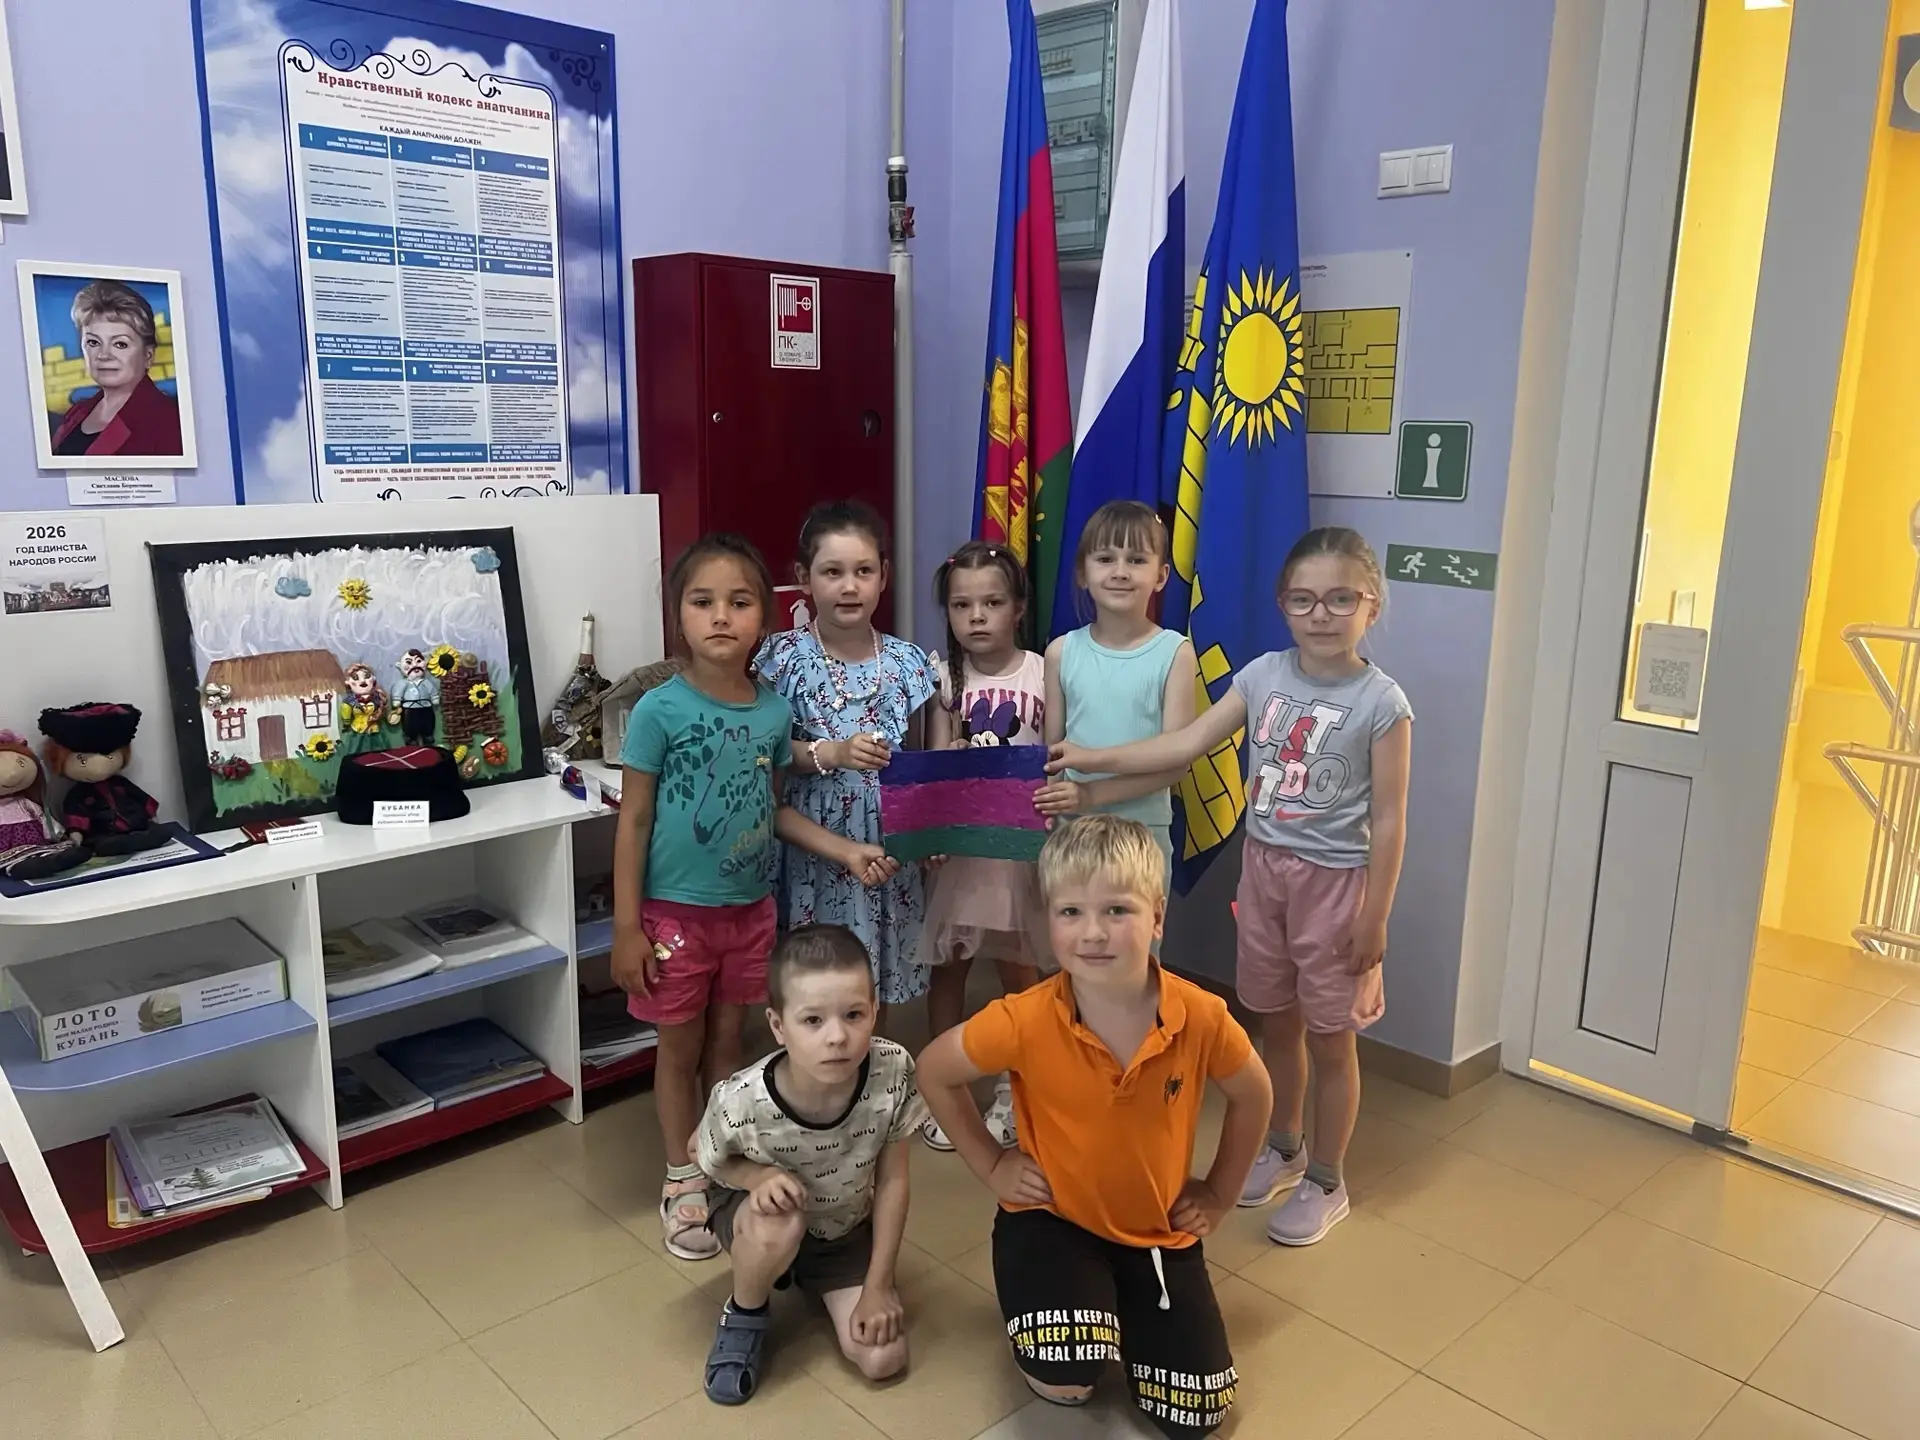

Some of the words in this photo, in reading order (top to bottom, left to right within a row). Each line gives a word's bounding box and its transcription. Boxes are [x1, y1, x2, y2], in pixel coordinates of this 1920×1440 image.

[318, 72, 423, 100] Нравственный
[427, 91, 473, 107] кодекс
[477, 100, 551, 121] анапчанина
[308, 132, 313, 142] 1
[379, 125, 411, 135] КАЖДЫЙ
[411, 130, 452, 141] АНАПЧАНИН
[397, 144, 403, 154] 2
[26, 525, 67, 540] 2026
[15, 546, 36, 555] ГОД
[37, 543, 88, 554] ЕДИНСТВА
[9, 557, 56, 567] НАРОДОВ
[58, 555, 97, 565] РОССИИ
[54, 1006, 116, 1031] ЛОТО
[56, 1030, 119, 1051] КУБАНЬ
[1022, 1312, 1033, 1328] IT
[1036, 1309, 1070, 1325] REAL
[1073, 1309, 1102, 1323] KEEP
[1104, 1312, 1112, 1326] IT
[1037, 1326, 1070, 1343] KEEP
[1074, 1326, 1088, 1340] IT
[1092, 1326, 1113, 1342] REAL
[1039, 1345, 1071, 1361] REAL
[1075, 1344, 1106, 1361] KEEP
[1154, 1367, 1168, 1384] IT
[1170, 1371, 1202, 1390] REAL
[1204, 1371, 1225, 1390] KEEP
[1138, 1381, 1167, 1401] REAL
[1170, 1389, 1202, 1408] KEEP
[1205, 1393, 1215, 1409] IT
[1156, 1402, 1168, 1418] IT
[1170, 1407, 1201, 1427] REAL
